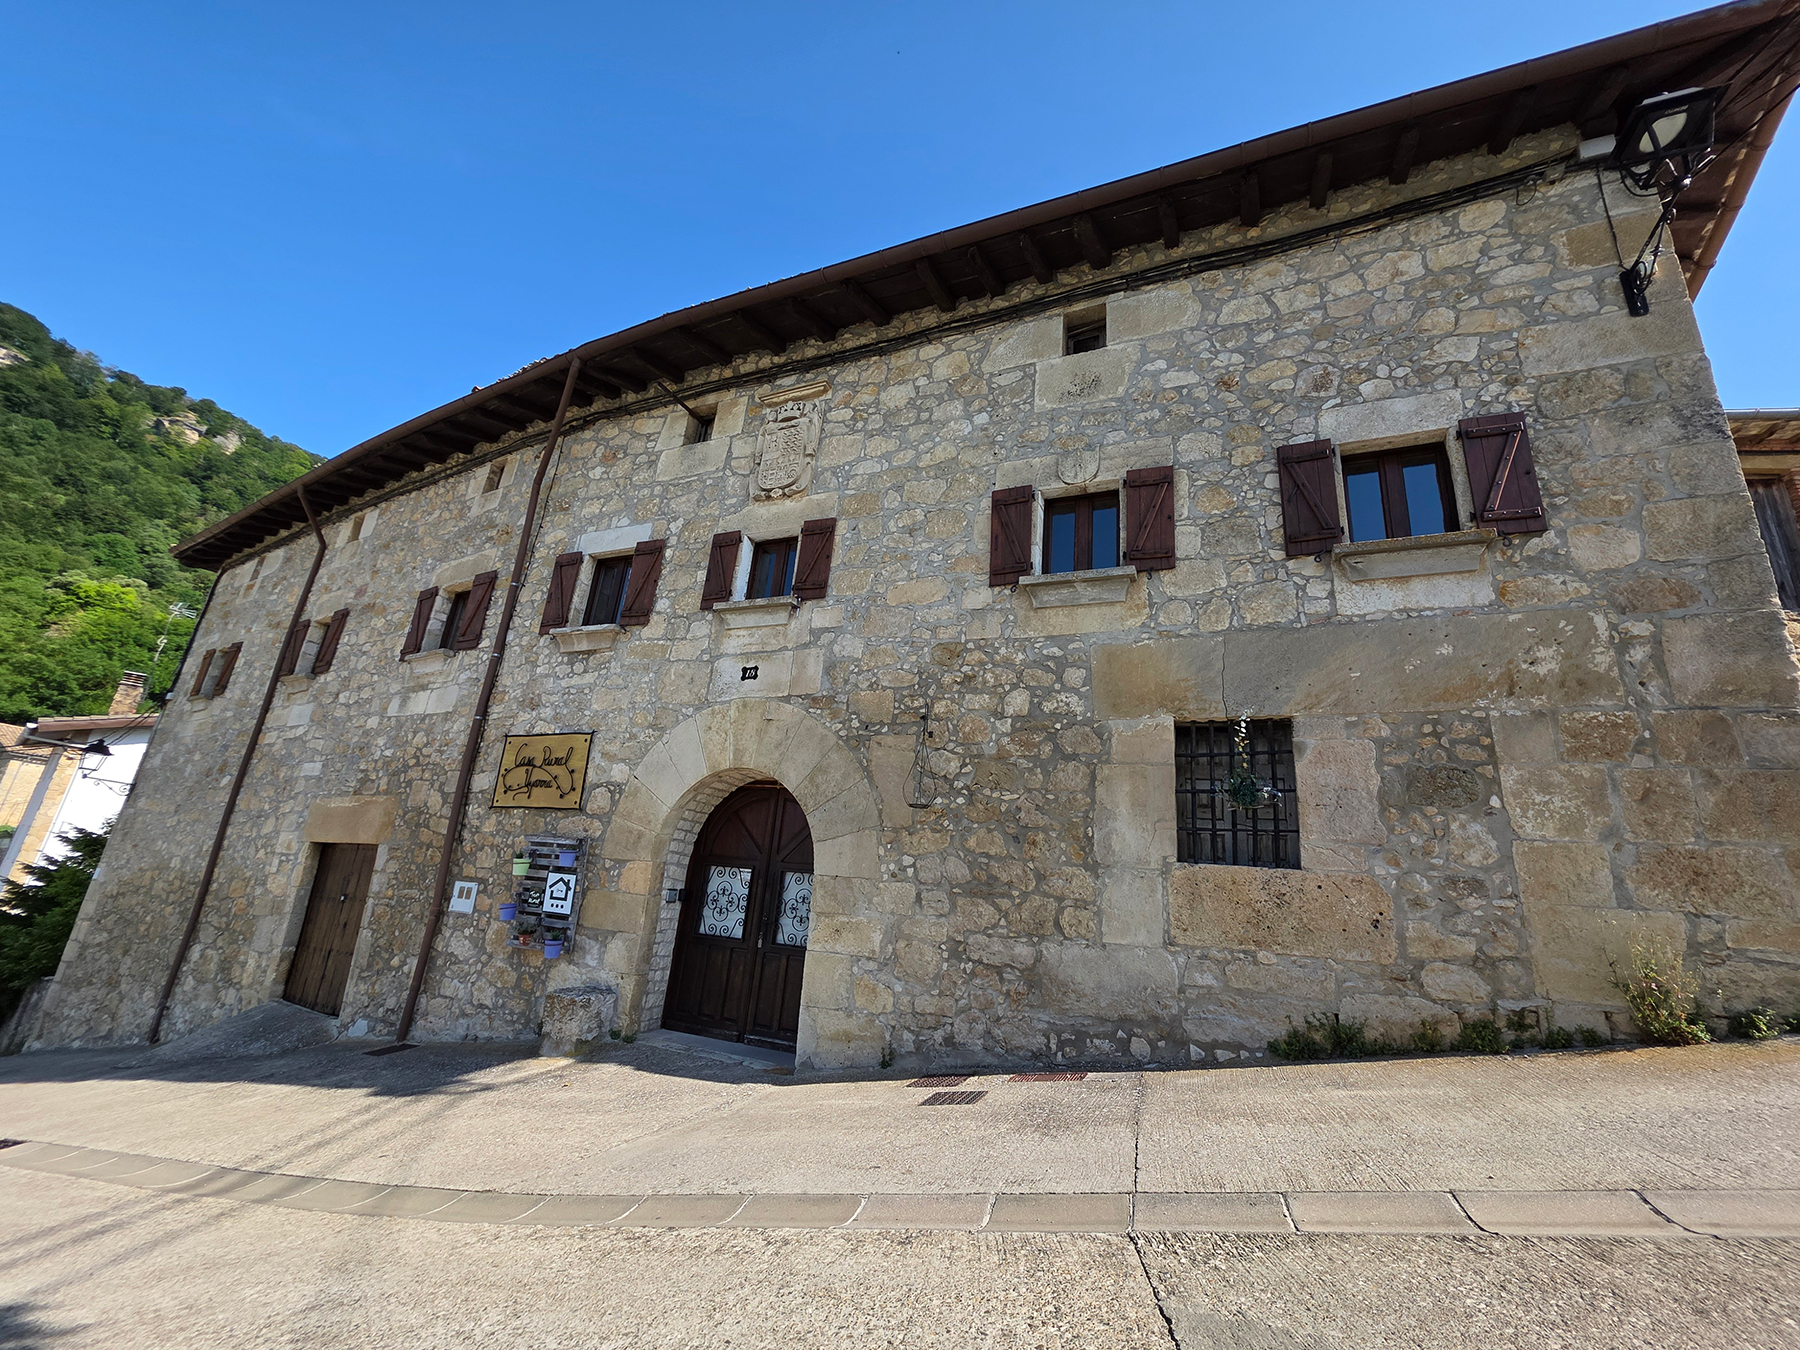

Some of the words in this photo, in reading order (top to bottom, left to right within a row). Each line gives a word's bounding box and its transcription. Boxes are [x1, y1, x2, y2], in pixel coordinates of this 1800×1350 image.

[745, 669, 756, 678] 18
[515, 743, 536, 767] Casa
[539, 746, 574, 768] Rural
